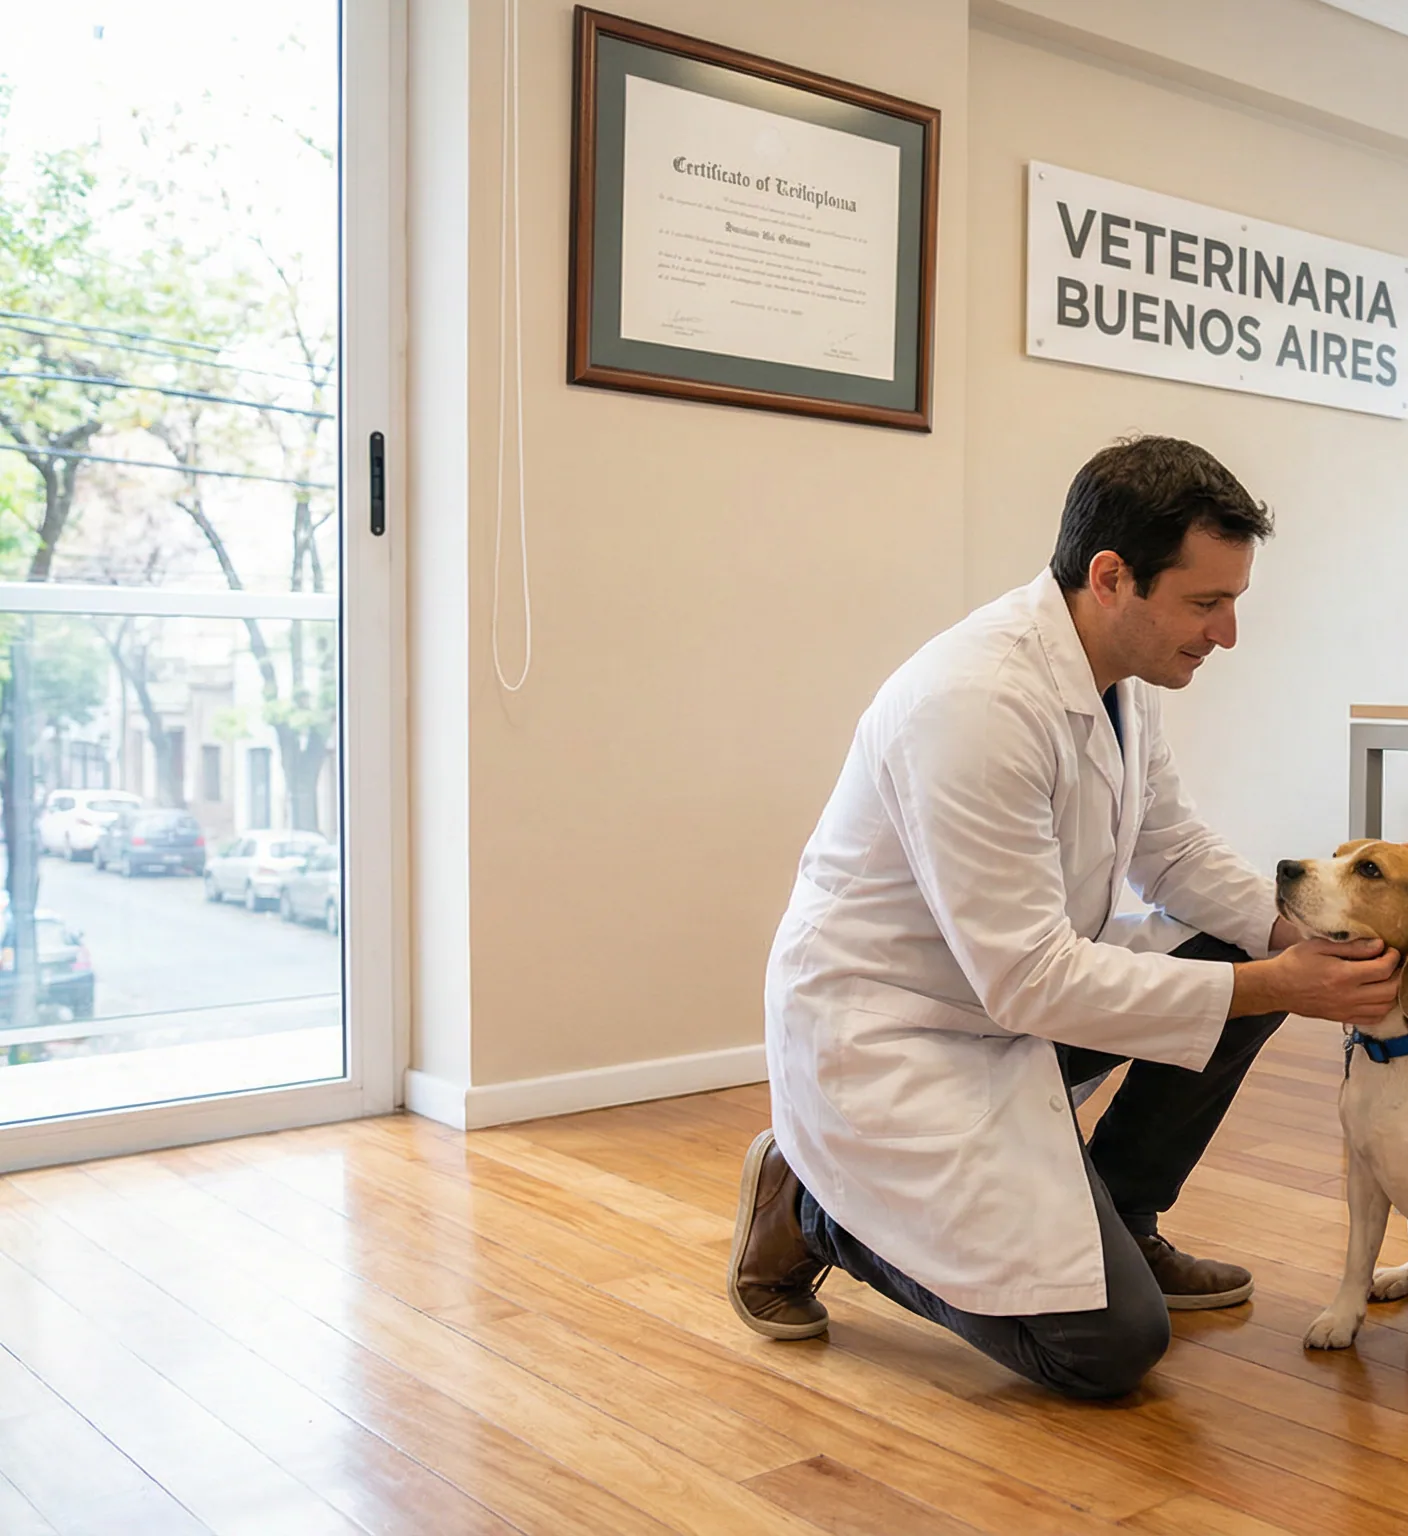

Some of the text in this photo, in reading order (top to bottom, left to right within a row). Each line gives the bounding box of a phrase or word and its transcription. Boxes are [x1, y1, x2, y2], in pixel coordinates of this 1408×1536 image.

[755, 176, 771, 192] of
[1056, 200, 1398, 329] VETERINARIA
[1056, 276, 1398, 388] BUENOS AIRES
